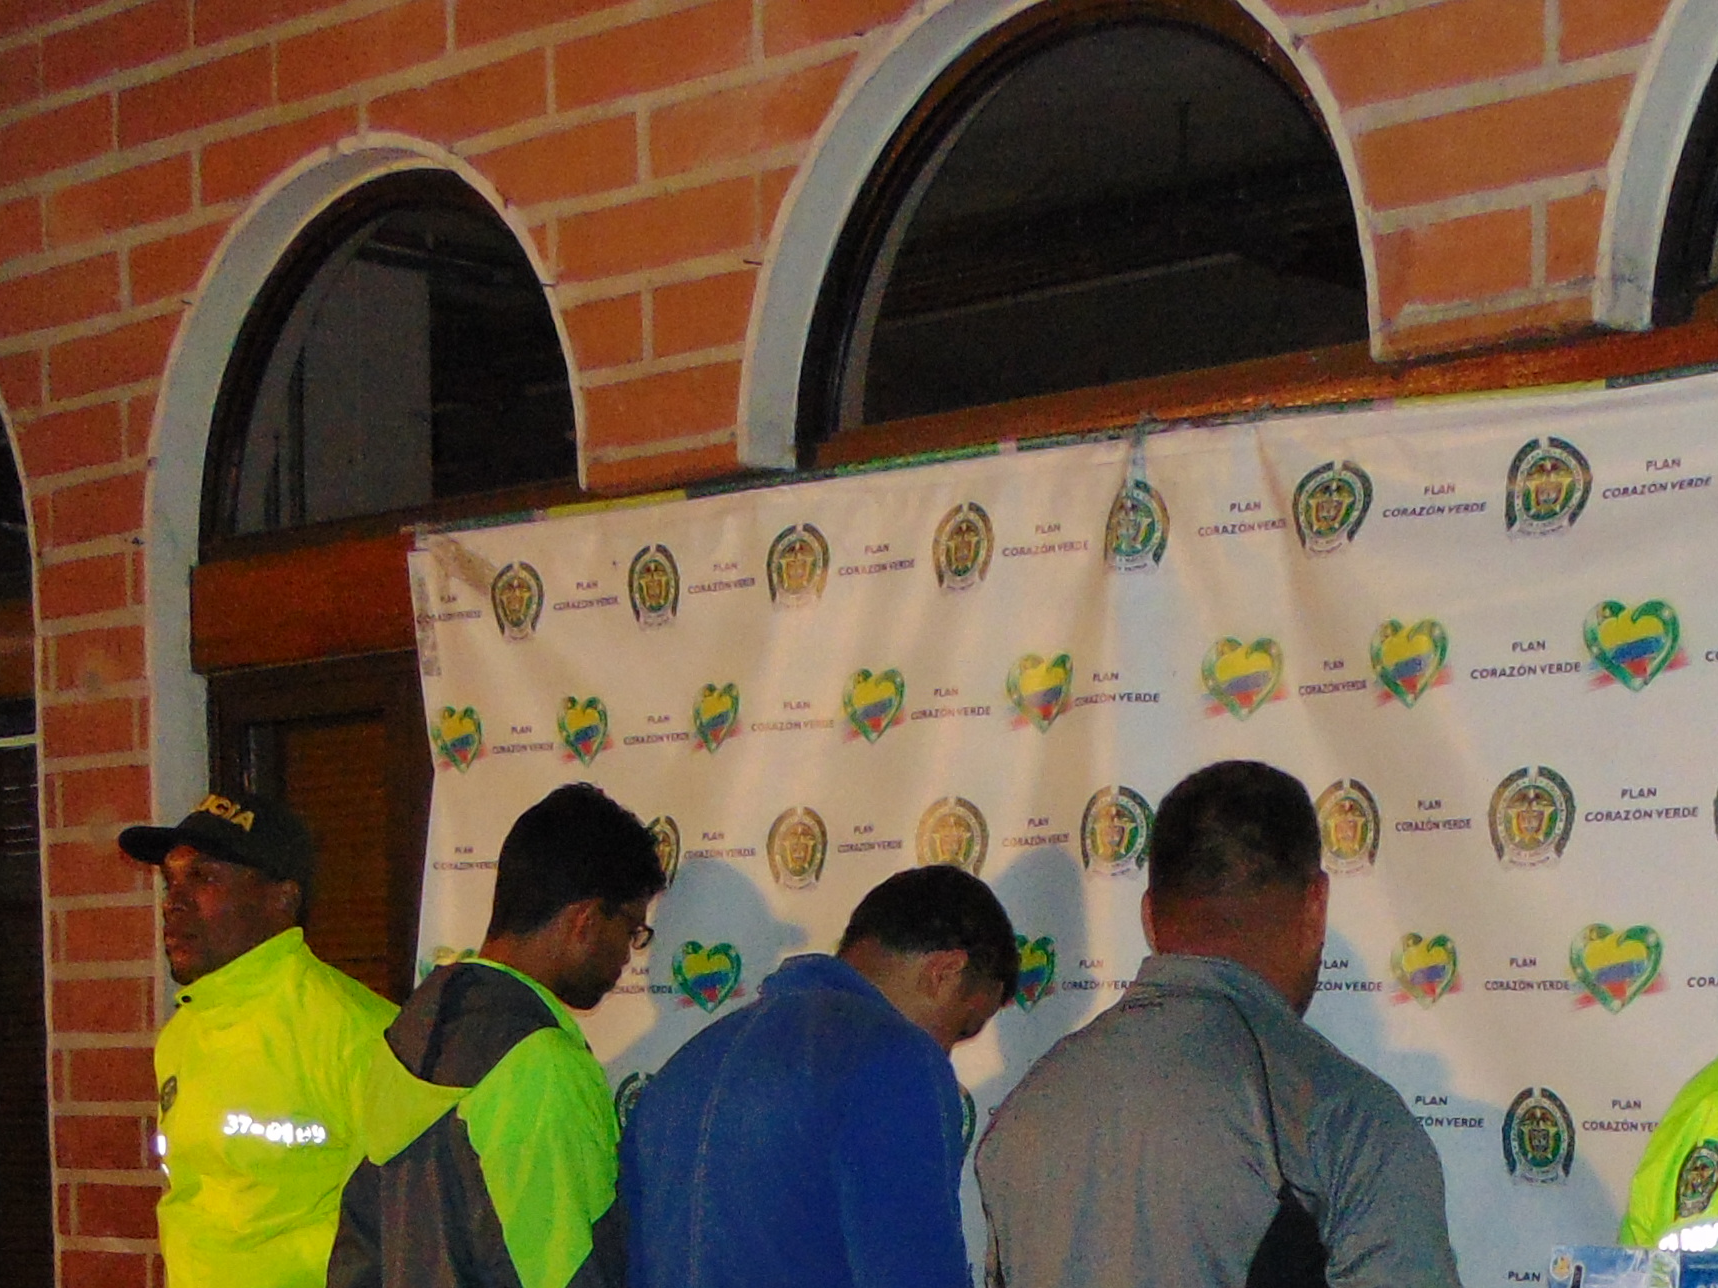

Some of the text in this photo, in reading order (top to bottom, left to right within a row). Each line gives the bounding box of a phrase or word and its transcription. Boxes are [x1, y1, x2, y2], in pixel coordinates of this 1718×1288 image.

[1646, 458, 1681, 472] PLAN
[1668, 476, 1712, 491] VERDE
[1424, 484, 1455, 495] PLAN
[1229, 502, 1261, 513] PLAN
[1446, 501, 1487, 514] VERDE
[1035, 524, 1060, 535] PLAN
[864, 543, 889, 553] PLAN
[1053, 541, 1088, 552] VERDE
[713, 561, 738, 572] PLAN
[1512, 640, 1546, 652] PLAN
[1323, 659, 1344, 670] PLAN
[1540, 661, 1581, 674] VERDE
[1093, 672, 1119, 682] PLAN
[934, 687, 958, 698] PLAN
[1118, 692, 1160, 704] VERDE
[784, 700, 810, 710] PLAN
[647, 715, 670, 724] PLAN
[1621, 787, 1657, 799] PLAN
[1418, 800, 1441, 810] PLAN
[1653, 807, 1698, 819] VERDE
[1027, 817, 1048, 828] PLAN
[853, 825, 873, 835] PLAN
[702, 833, 724, 841] PLAN
[1079, 960, 1104, 969] PLAN
[1509, 958, 1536, 968] PLAN
[1345, 981, 1382, 992] VERDE
[1535, 979, 1570, 991] VERDE
[1414, 1095, 1447, 1106] PLAN
[1612, 1099, 1642, 1110] PLAN
[1446, 1116, 1484, 1128] VERDE
[1508, 1271, 1541, 1282] PLAN
